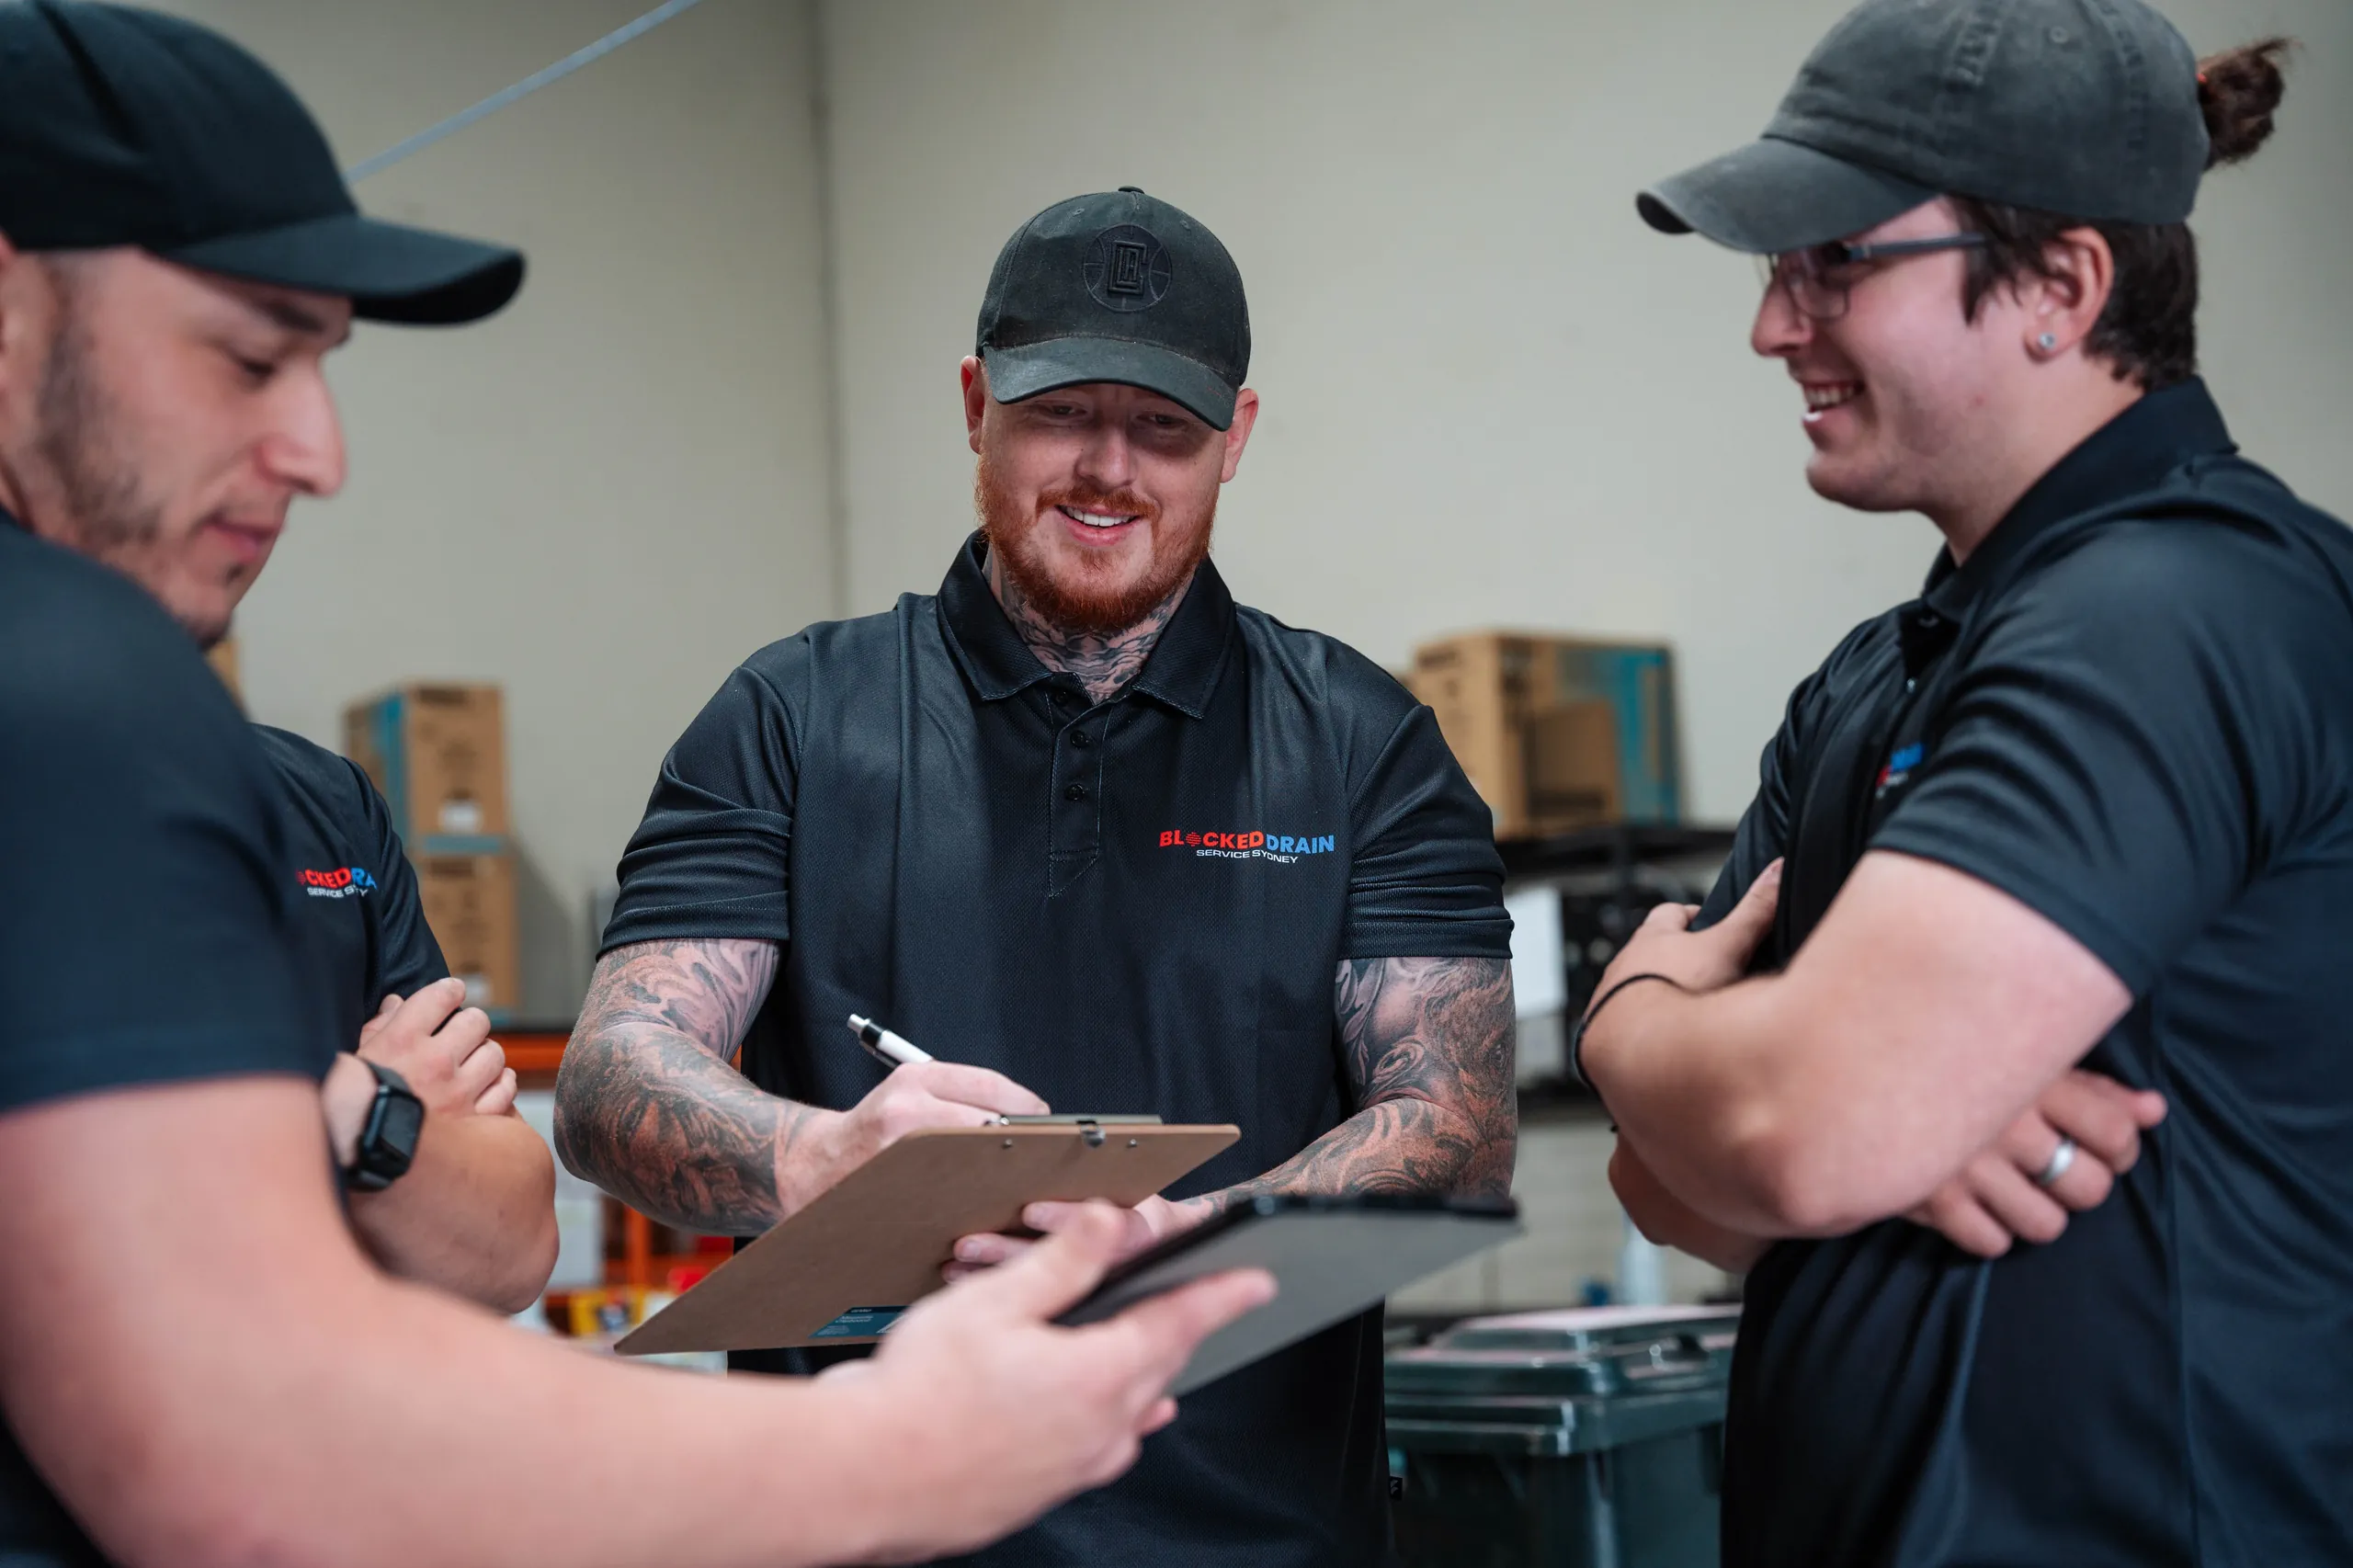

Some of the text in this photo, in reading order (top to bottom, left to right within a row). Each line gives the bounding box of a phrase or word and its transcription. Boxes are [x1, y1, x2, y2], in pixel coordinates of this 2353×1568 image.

[1196, 849, 1299, 864] SERVICE SYDNEY
[307, 887, 344, 898] SERVICE
